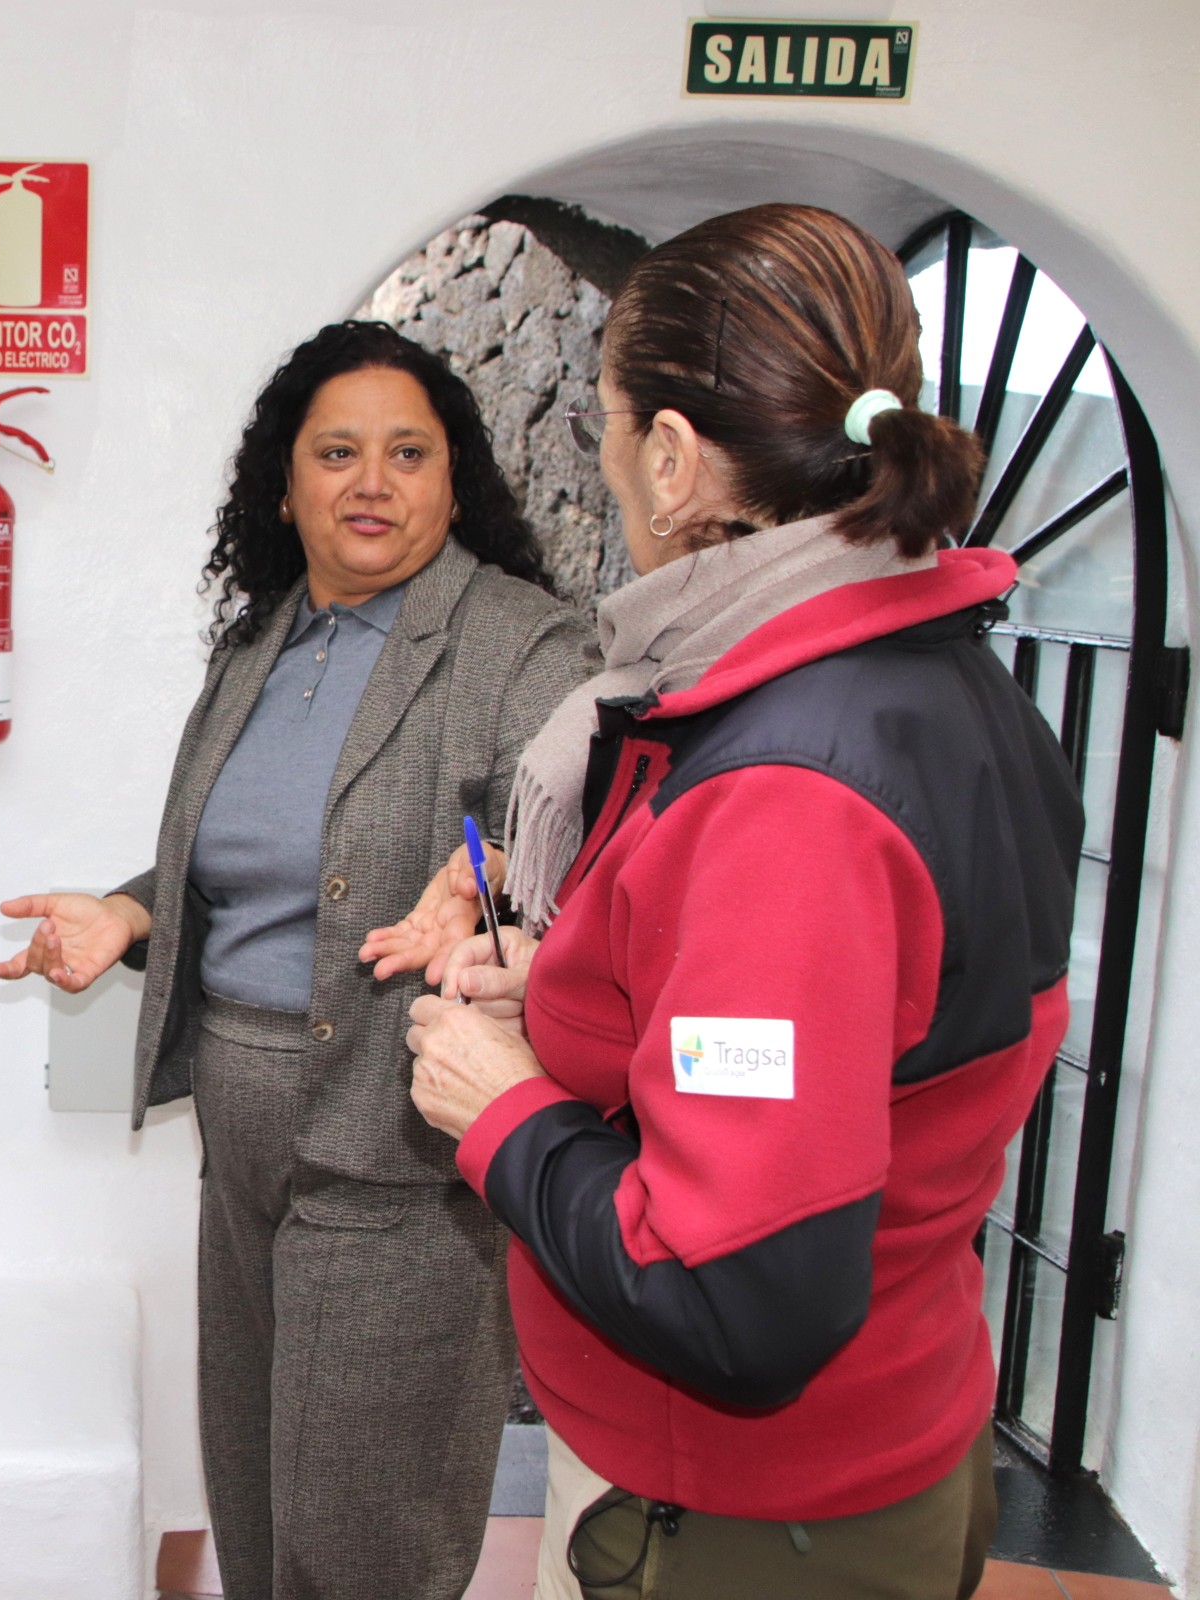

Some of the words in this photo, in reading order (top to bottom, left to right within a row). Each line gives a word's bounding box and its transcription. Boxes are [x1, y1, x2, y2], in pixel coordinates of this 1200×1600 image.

[703, 34, 891, 86] SALIDA
[5, 351, 70, 369] ELECTRICO
[713, 1041, 787, 1072] Tragsa
